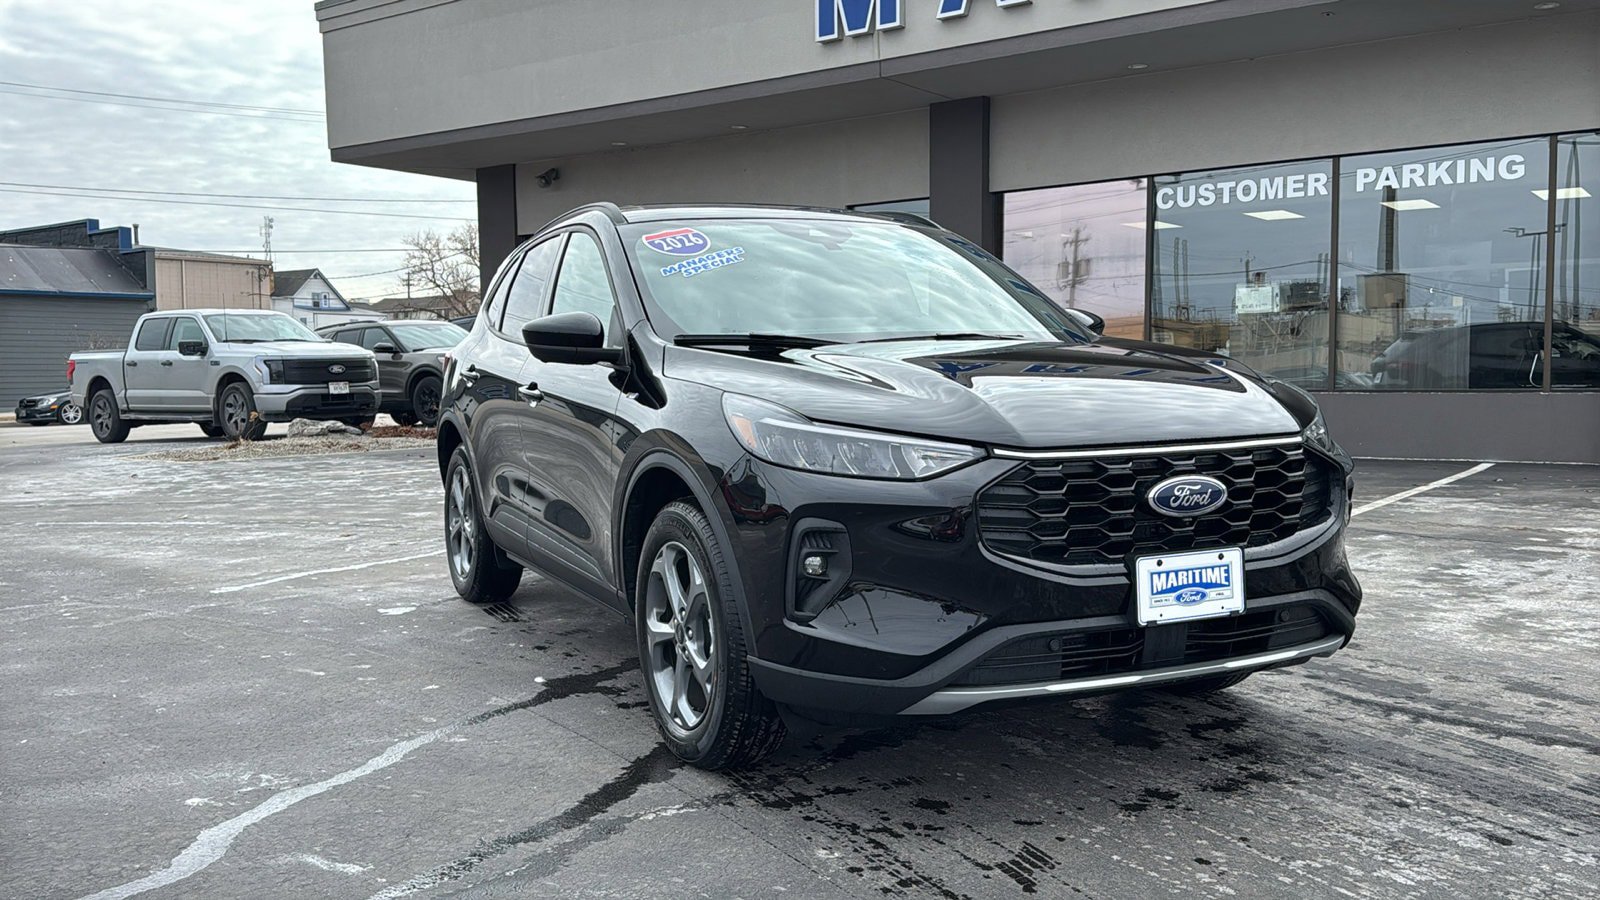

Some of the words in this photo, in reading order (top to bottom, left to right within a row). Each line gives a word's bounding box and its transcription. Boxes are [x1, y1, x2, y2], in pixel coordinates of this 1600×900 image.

[1156, 173, 1328, 210] CUSTOMER
[1356, 154, 1526, 192] PARKING
[655, 232, 703, 251] 2026
[662, 247, 744, 276] MANAGERS
[682, 254, 744, 277] SPECIAL
[1170, 485, 1212, 507] Ford
[1152, 566, 1229, 594] MARITIME
[1180, 590, 1202, 602] Ford
